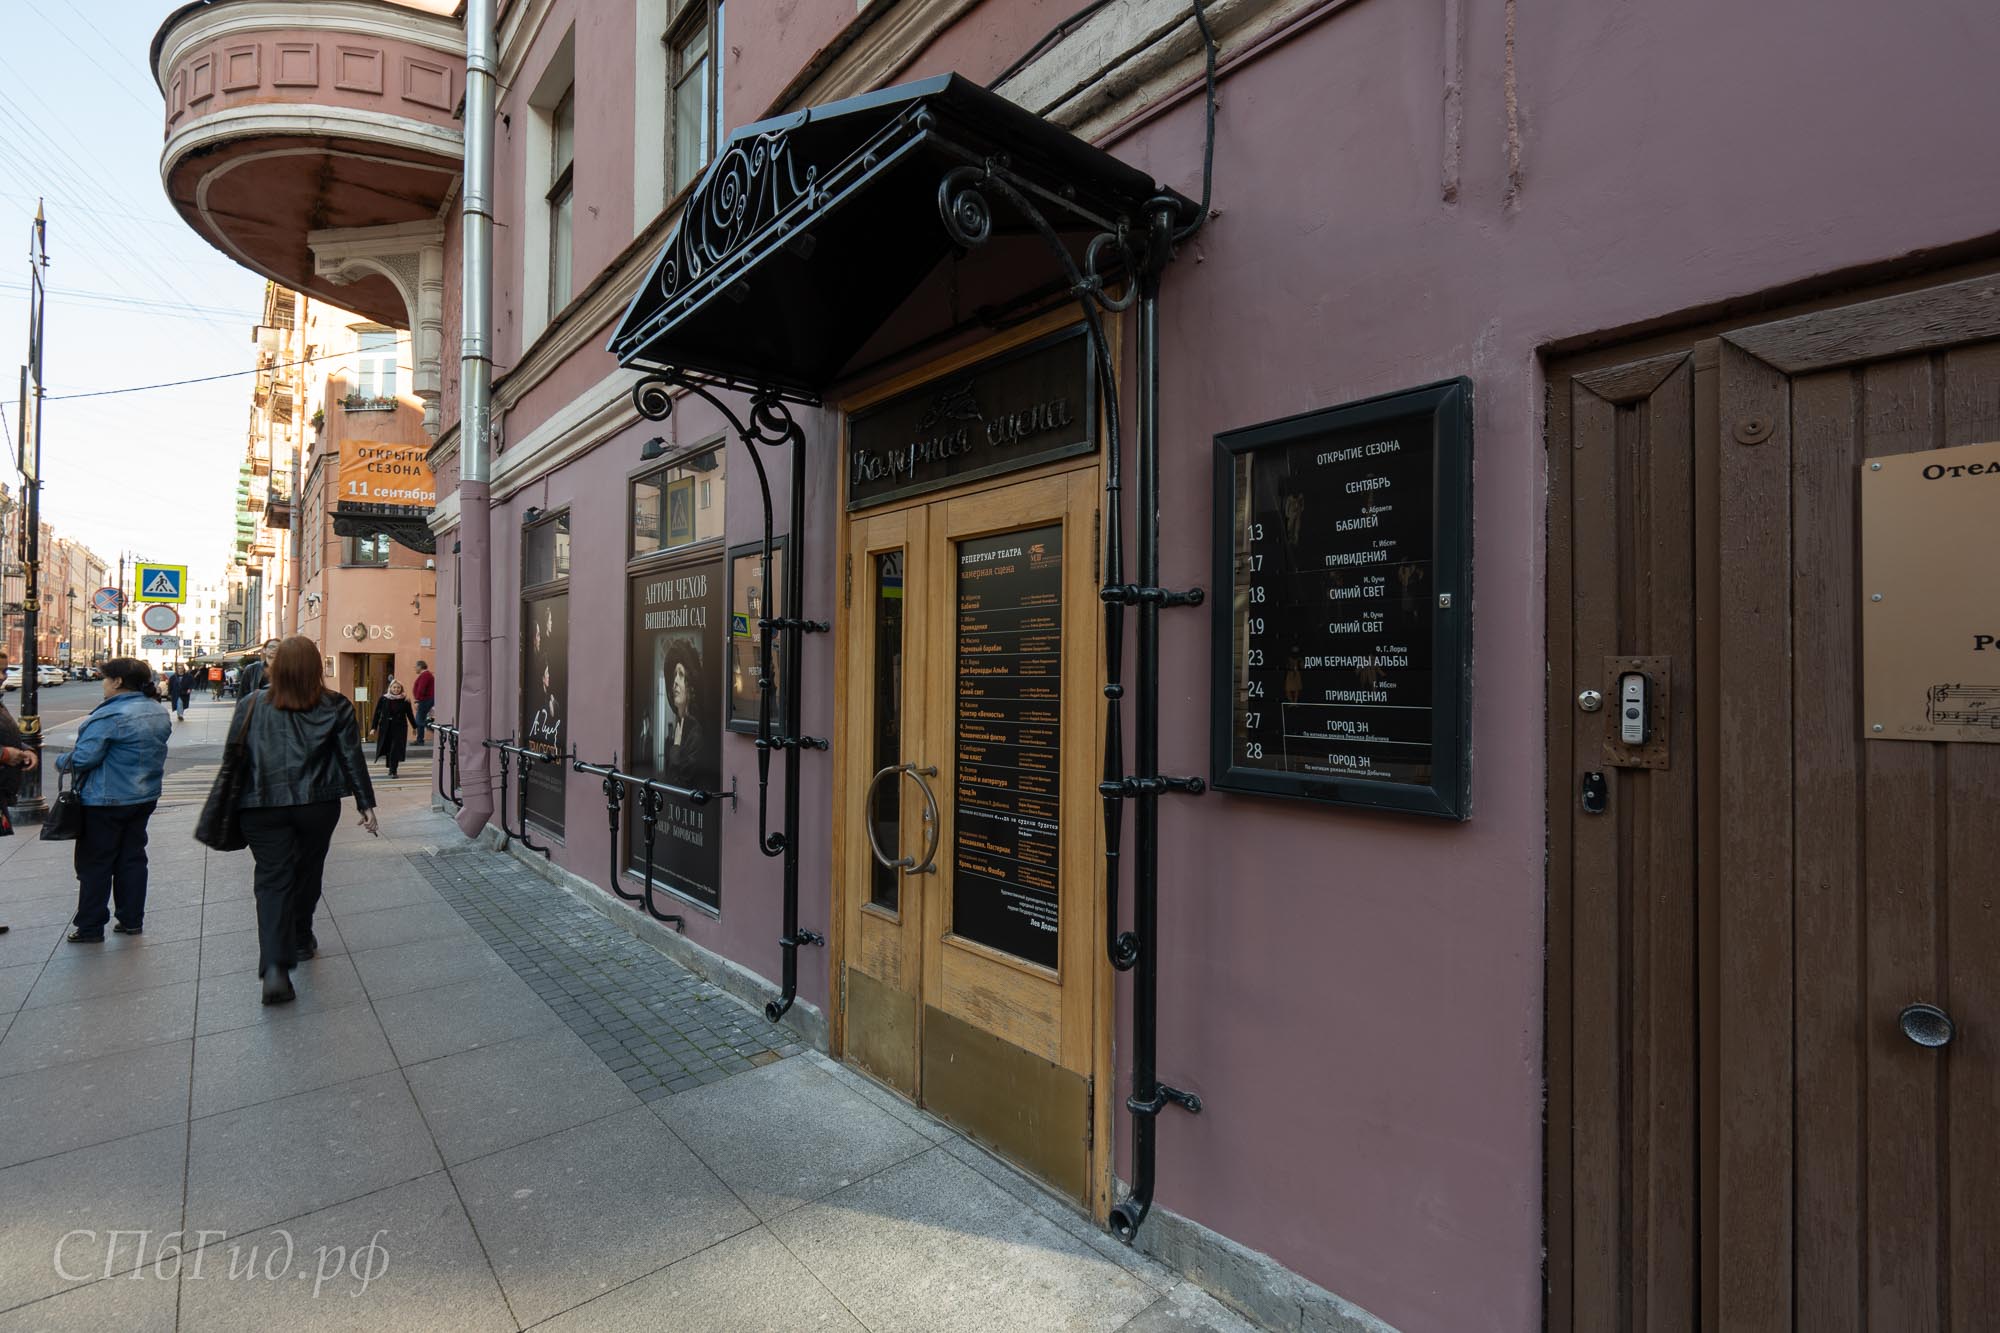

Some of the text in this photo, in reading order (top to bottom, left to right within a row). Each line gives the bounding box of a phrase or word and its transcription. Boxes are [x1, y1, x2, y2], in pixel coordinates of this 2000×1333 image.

[358, 448, 426, 462] ОТКРЫТИ
[1317, 439, 1400, 465] ОТКРЫТИЕ СЕЗОНА
[367, 462, 421, 476] СЕЗОНА
[348, 480, 436, 501] 11 сентября
[1345, 476, 1391, 494] СЕНТЯБРЬ
[1336, 514, 1378, 532] БАБИЛЕЙ
[1247, 523, 1264, 541] 13
[1378, 538, 1397, 548] Ибсен
[961, 551, 996, 564] РЕПЕРТУАР
[997, 547, 1022, 559] ТЕАТРА
[1247, 554, 1263, 572] 17
[1325, 549, 1387, 566] ПРИВИДЕНИЯ
[644, 574, 707, 605] АНТОН ЧЕХОВ
[1249, 586, 1266, 603] 18
[1329, 585, 1385, 600] СИНИЙ СВЕТ
[645, 604, 707, 630] ВИШНЕВЫЙ САД
[1248, 618, 1265, 635] 19
[1329, 619, 1383, 634] СИНИЙ СВЕТ
[1247, 649, 1264, 666] 23
[1304, 655, 1408, 669] ДОМ БЕРНАРДЫ АЛЬБЫ
[1247, 681, 1264, 698] 24
[1379, 680, 1397, 688] Ибсен
[1325, 690, 1387, 703] ПРИВИДЕНИЯ
[1245, 712, 1261, 729] 27
[1327, 720, 1369, 733] ГОРОД ЭН
[1246, 742, 1263, 759] 28
[1328, 754, 1370, 768] ГОРОД ЭН
[668, 803, 703, 829] ДОДИН
